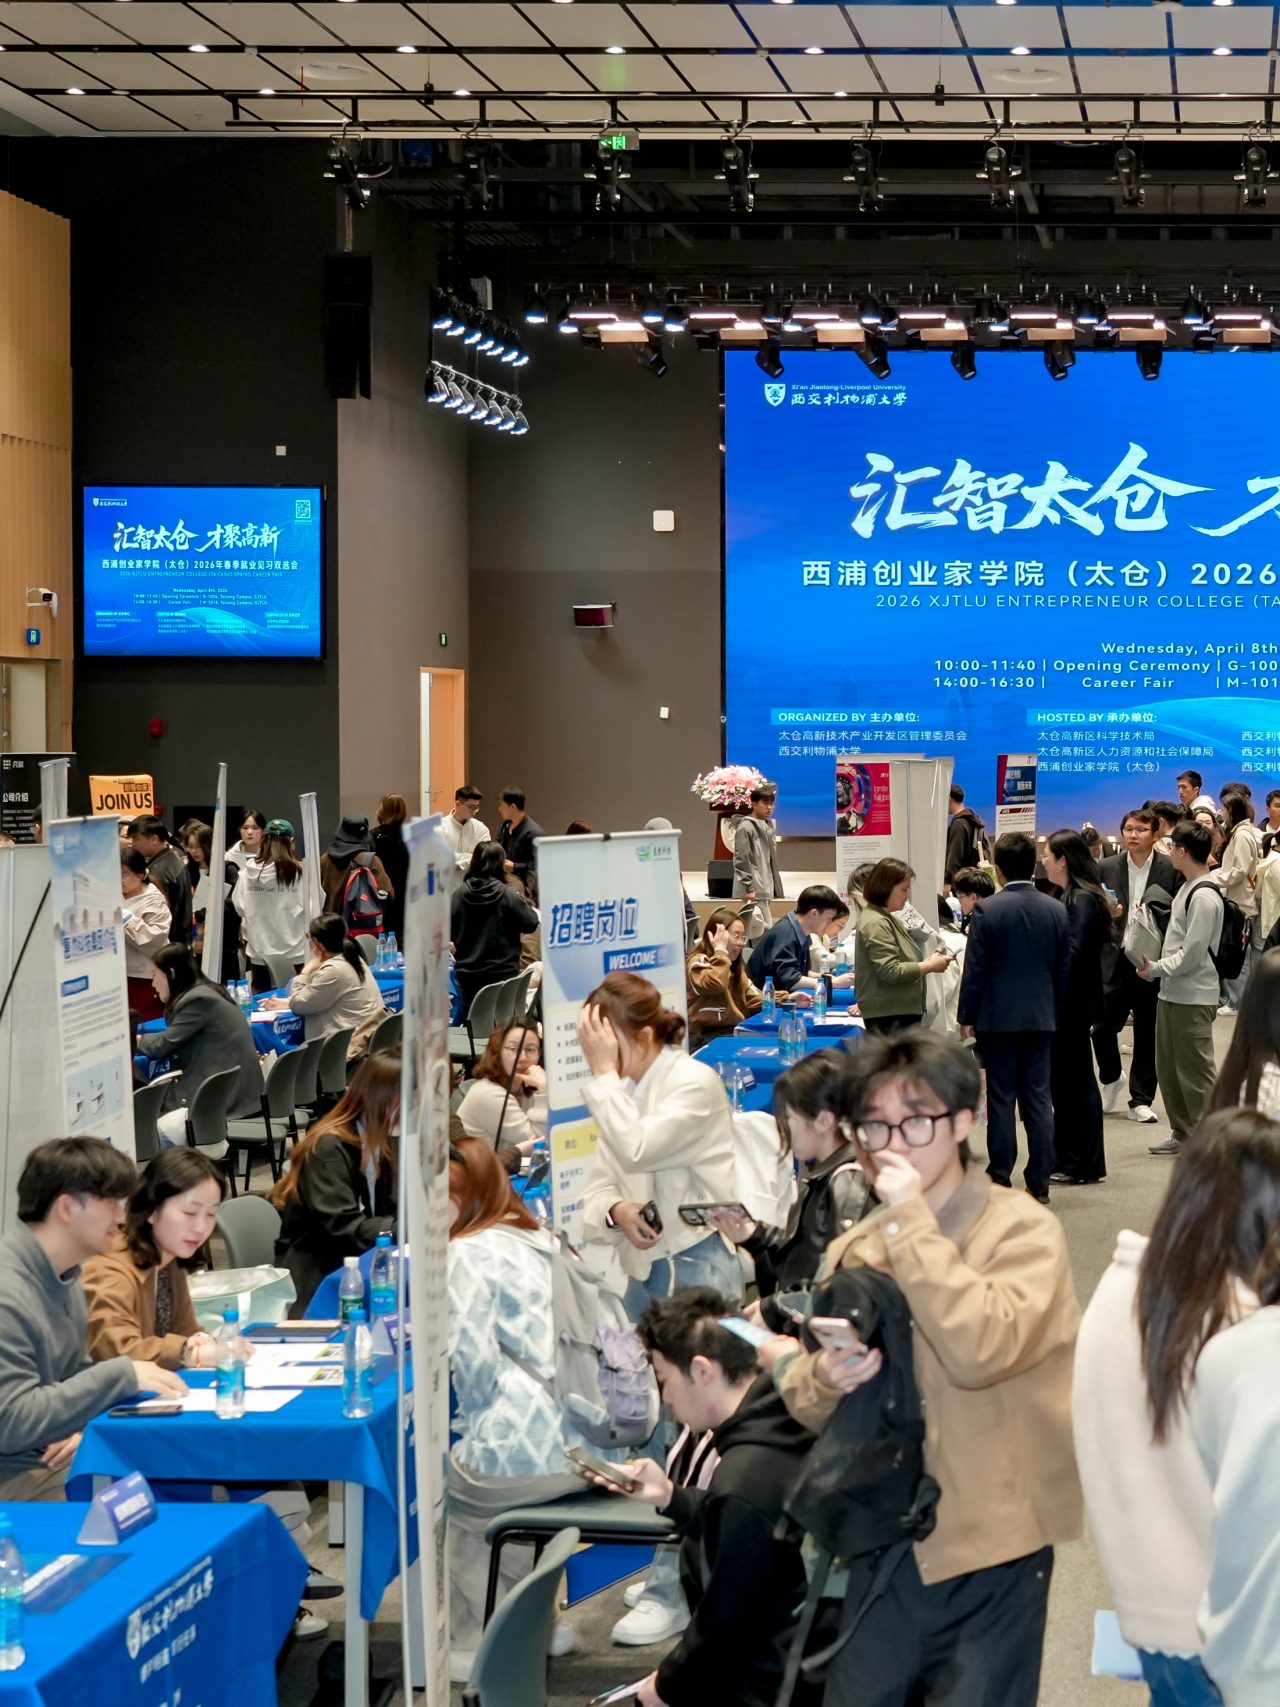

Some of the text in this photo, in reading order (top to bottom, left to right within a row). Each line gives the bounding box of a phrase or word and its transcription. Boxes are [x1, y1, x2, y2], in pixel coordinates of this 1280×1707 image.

[850, 442, 1215, 539] 汇智太仓
[113, 518, 285, 559] 汇智太仓 才聚高新
[876, 595, 920, 608] 2026
[929, 595, 986, 608] XJTLU
[996, 595, 1148, 608] ENTREPRENEUR
[1157, 595, 1243, 608] COLLEGE
[1102, 643, 1198, 656] Wednesday,
[1204, 643, 1244, 656] April
[935, 660, 1036, 673] 10:00-11:40
[1053, 660, 1122, 673] Opening
[1129, 660, 1210, 673] Ceremony
[934, 677, 1035, 690] 14:00-16:30
[1082, 677, 1136, 690] Career
[1143, 677, 1174, 690] Fair
[779, 712, 920, 723] ORGANIZED BY 主办单位:
[1037, 712, 1157, 723] HOSTED BY 承办单位:
[778, 730, 967, 741] 太仓高新技术产业开发区管理委员会
[1037, 730, 1155, 741] 太仓高新区科学技术局
[778, 745, 861, 756] 西交利物浦大学
[1037, 746, 1214, 757] 太仓高新区人力资源和社会保障局
[96, 792, 152, 811] JOIN US
[549, 897, 639, 947] 招聘岗位
[609, 950, 657, 970] WELCOME
